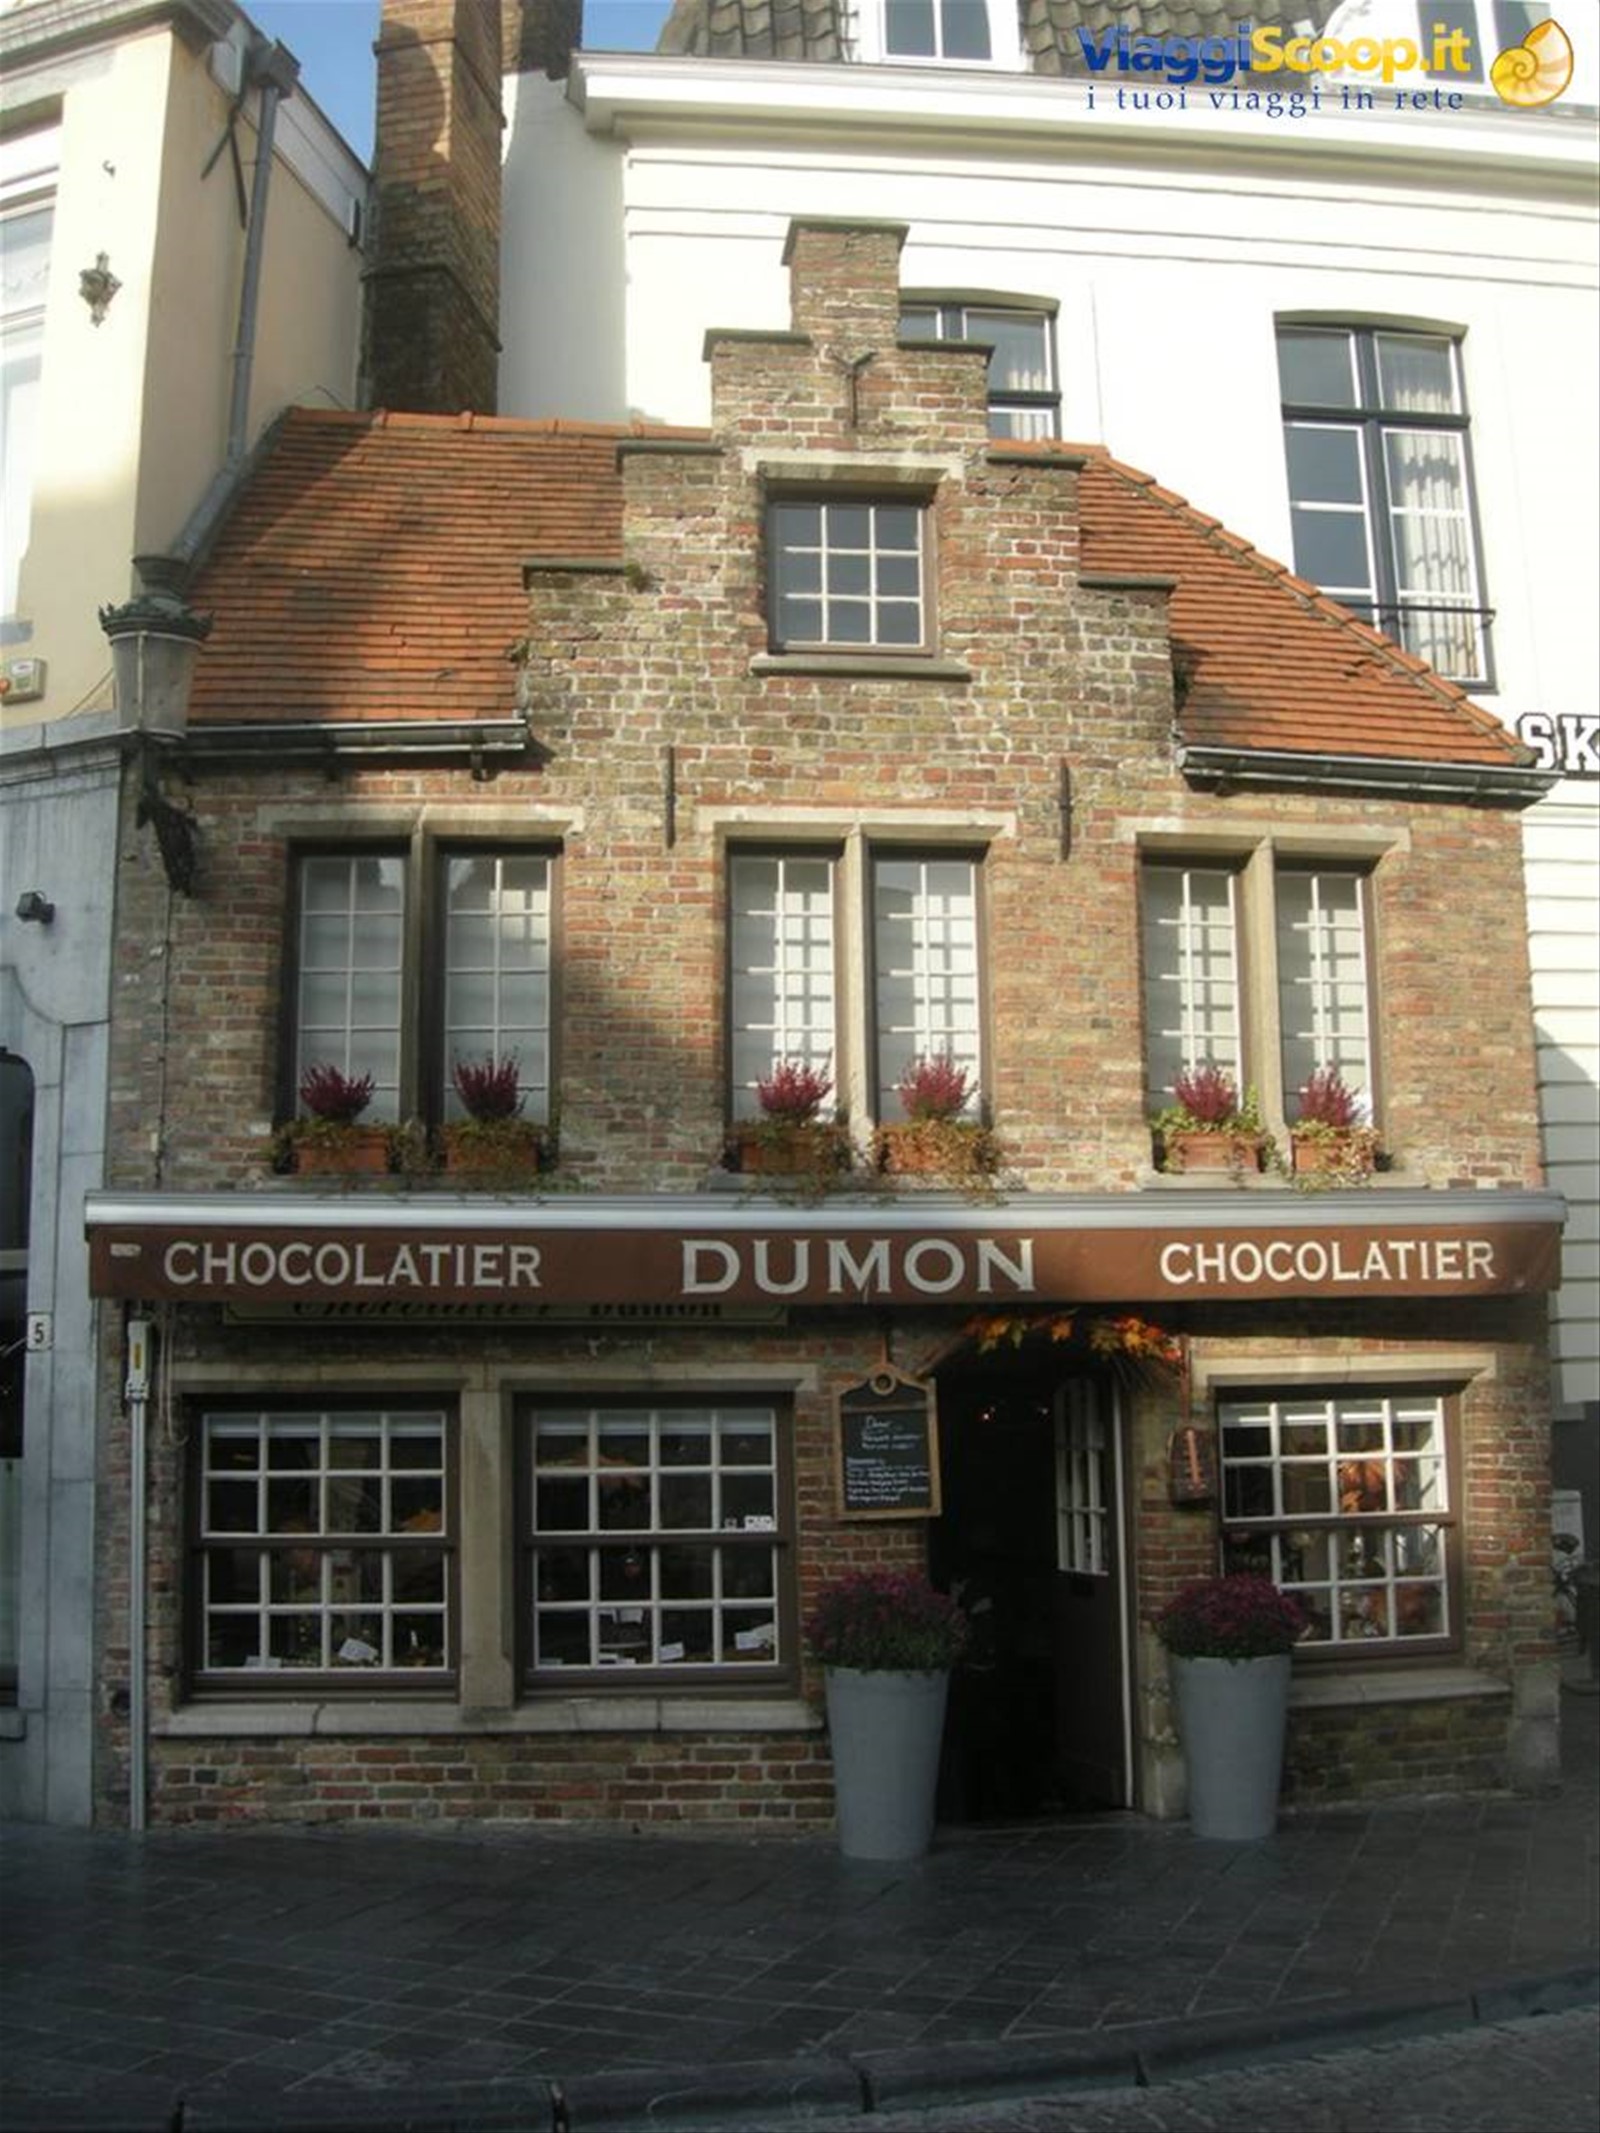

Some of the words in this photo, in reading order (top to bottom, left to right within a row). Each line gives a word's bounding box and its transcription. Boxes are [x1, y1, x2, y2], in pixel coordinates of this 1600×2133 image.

[163, 1241, 542, 1287] CHOCOLATIER
[681, 1238, 1035, 1294] DUMON
[1159, 1239, 1496, 1284] CHOCOLATIER
[34, 1322, 44, 1344] 5
